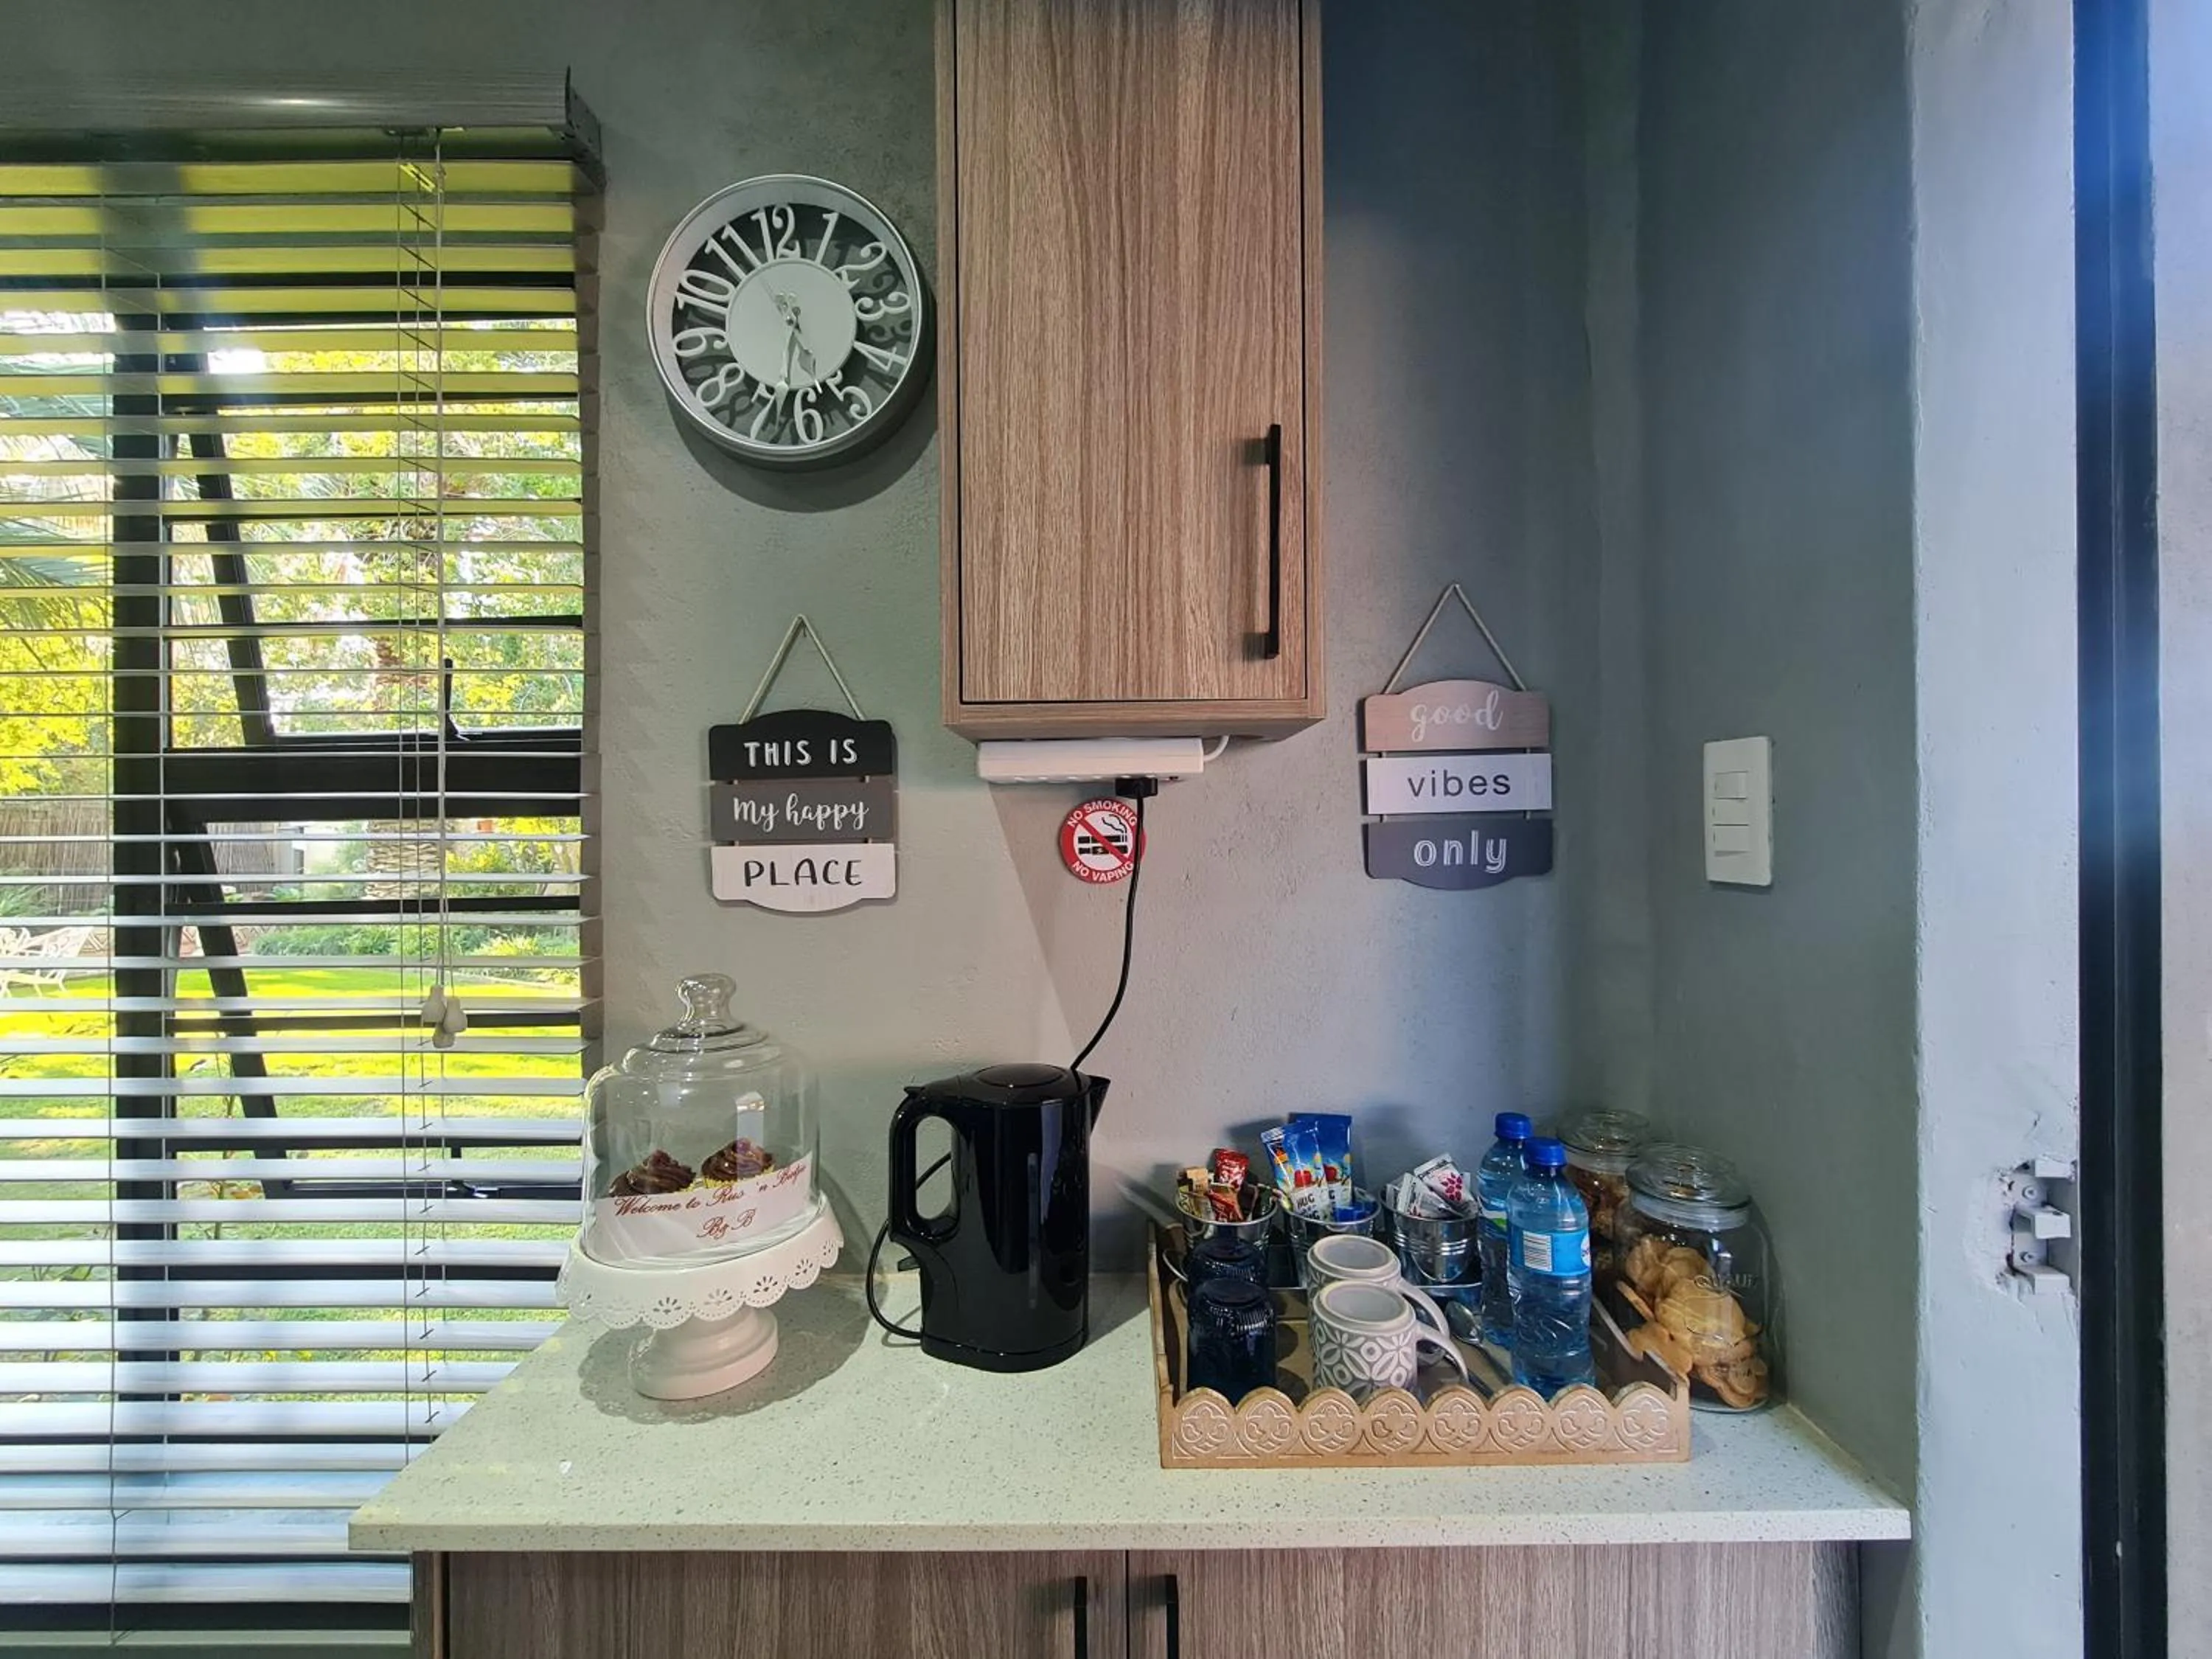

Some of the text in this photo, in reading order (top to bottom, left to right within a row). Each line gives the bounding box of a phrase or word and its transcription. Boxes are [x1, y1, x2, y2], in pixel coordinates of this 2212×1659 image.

[704, 223, 762, 282] 11
[751, 204, 801, 262] 12
[815, 212, 840, 265] 1
[833, 242, 886, 291] 2
[675, 269, 739, 316] 10
[855, 291, 911, 321] 3
[672, 327, 728, 357] 9
[853, 340, 908, 371] 4
[695, 362, 745, 407] 8
[826, 369, 873, 420] 5
[751, 382, 776, 440] 7
[793, 387, 824, 443] 6
[1409, 689, 1504, 742] good
[743, 738, 858, 768] THIS IS
[1407, 769, 1512, 798] vibes
[785, 793, 870, 831] happy
[1067, 800, 1137, 827] NO SMOKING
[743, 858, 863, 887] PLACE
[1072, 860, 1134, 882] NO VAPING
[1413, 830, 1507, 874] only
[613, 1195, 682, 1217] Welcome
[685, 1196, 701, 1210] to
